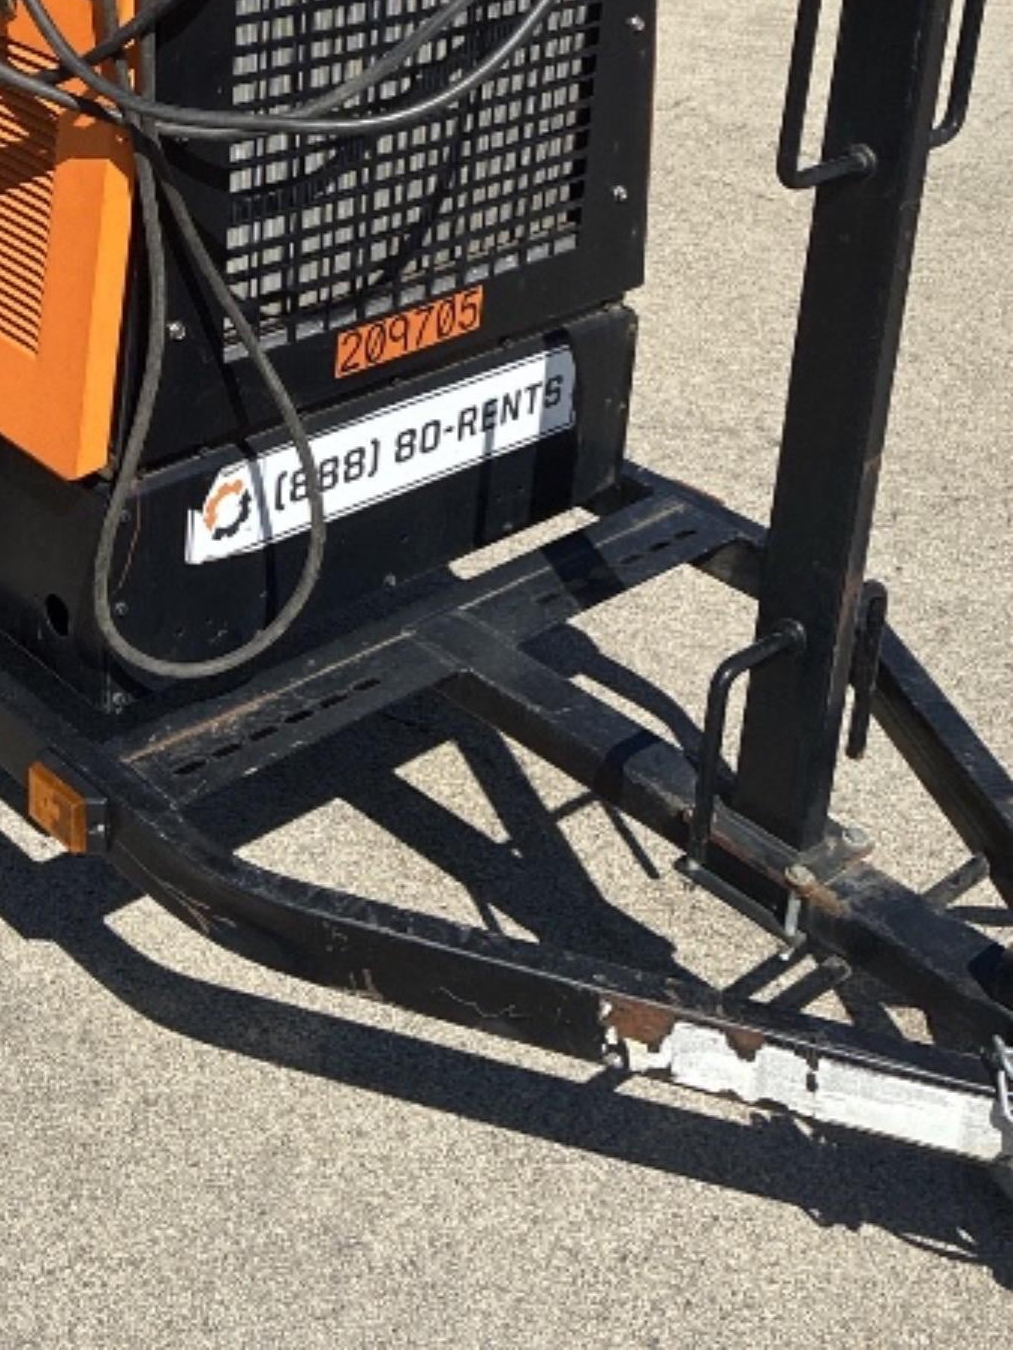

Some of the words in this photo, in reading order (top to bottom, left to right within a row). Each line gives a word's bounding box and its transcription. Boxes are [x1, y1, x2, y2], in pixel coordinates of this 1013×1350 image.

[339, 288, 478, 374] 209705
[274, 437, 381, 512] (888)
[393, 374, 565, 464] 80-RENTS
